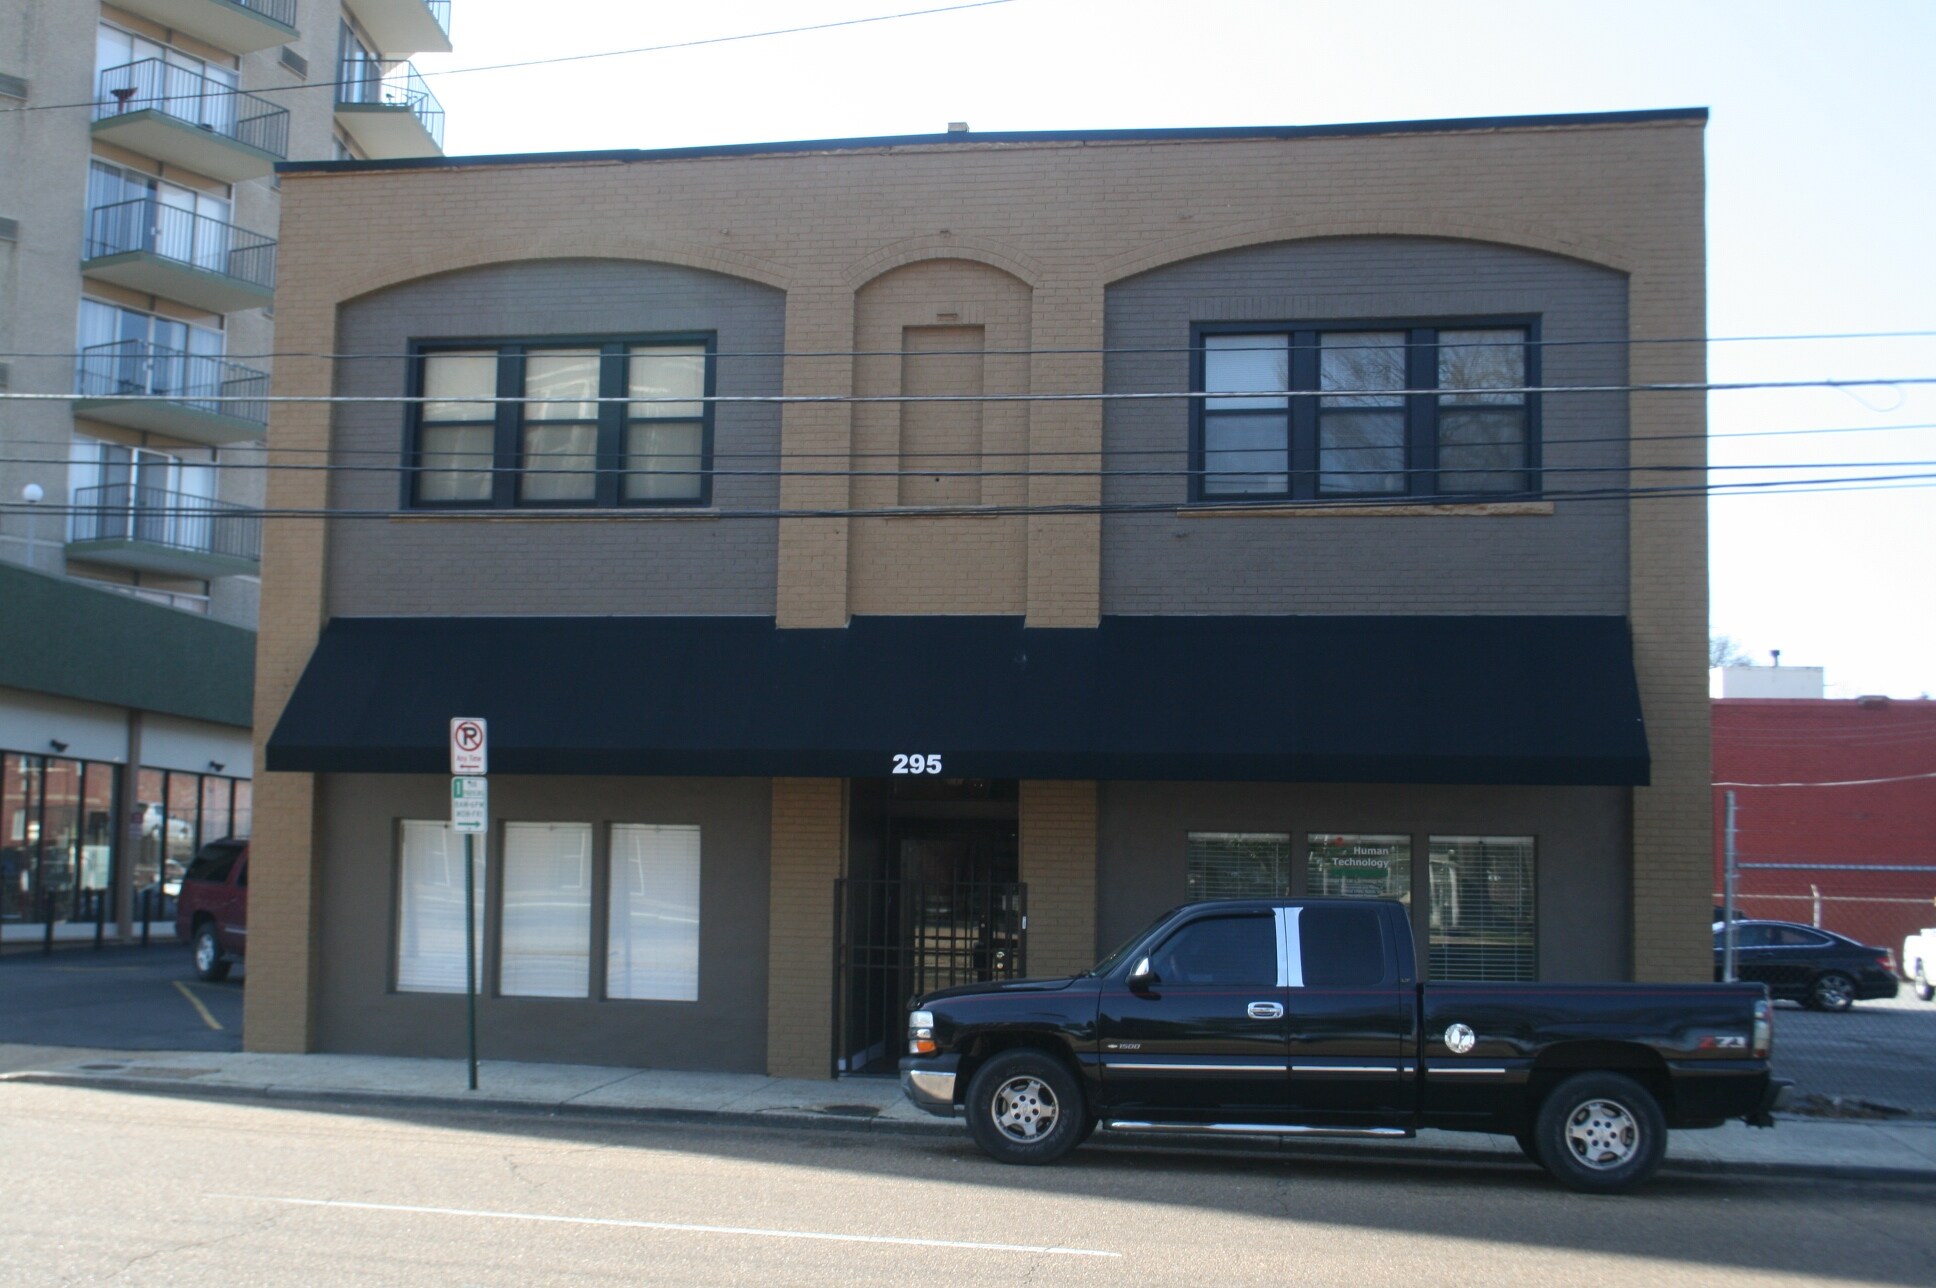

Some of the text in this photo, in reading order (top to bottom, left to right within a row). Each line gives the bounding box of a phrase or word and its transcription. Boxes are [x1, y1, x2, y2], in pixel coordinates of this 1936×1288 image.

[456, 755, 468, 763] Any
[892, 753, 942, 774] 295
[1353, 846, 1389, 855] Human
[1331, 857, 1389, 868] Technology
[1699, 1036, 1746, 1048] Z71
